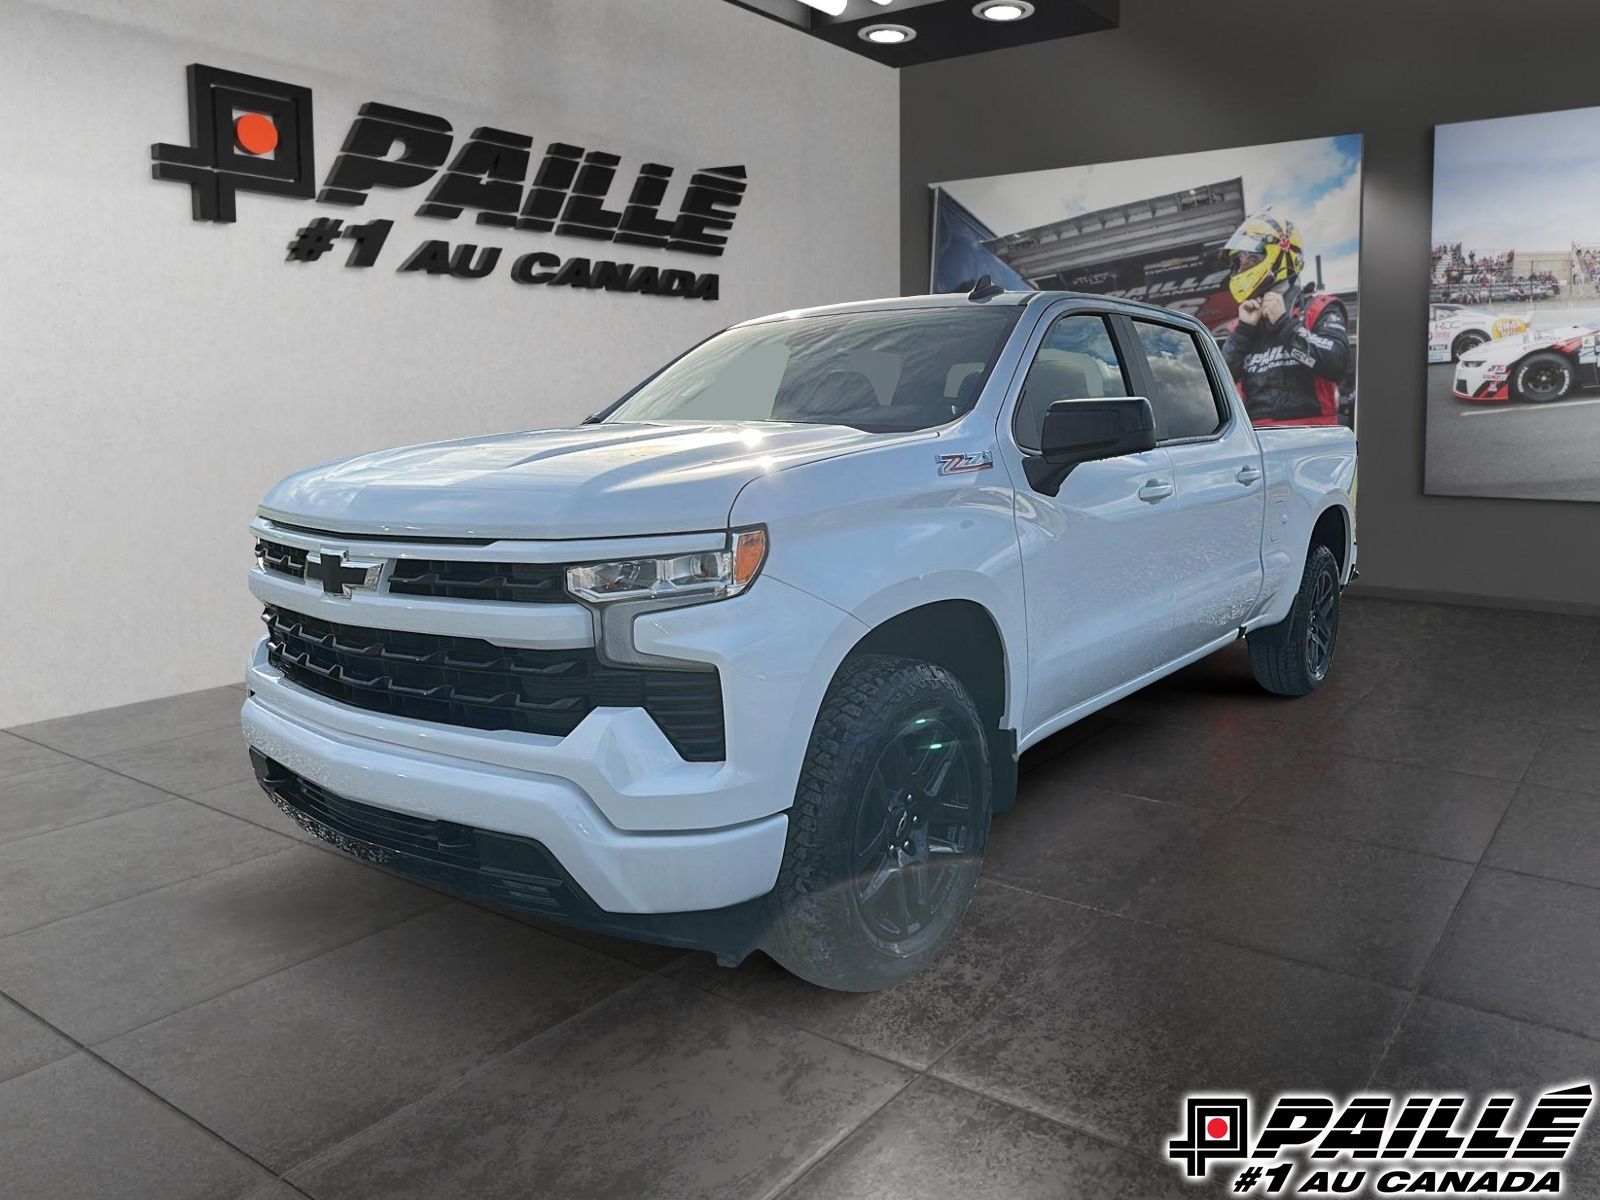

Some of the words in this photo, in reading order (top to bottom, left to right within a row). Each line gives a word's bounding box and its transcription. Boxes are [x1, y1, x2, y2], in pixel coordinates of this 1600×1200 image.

[315, 101, 747, 257] PAILLÉ
[285, 216, 395, 268] #1
[398, 239, 503, 279] AU
[510, 251, 720, 301] CANADA
